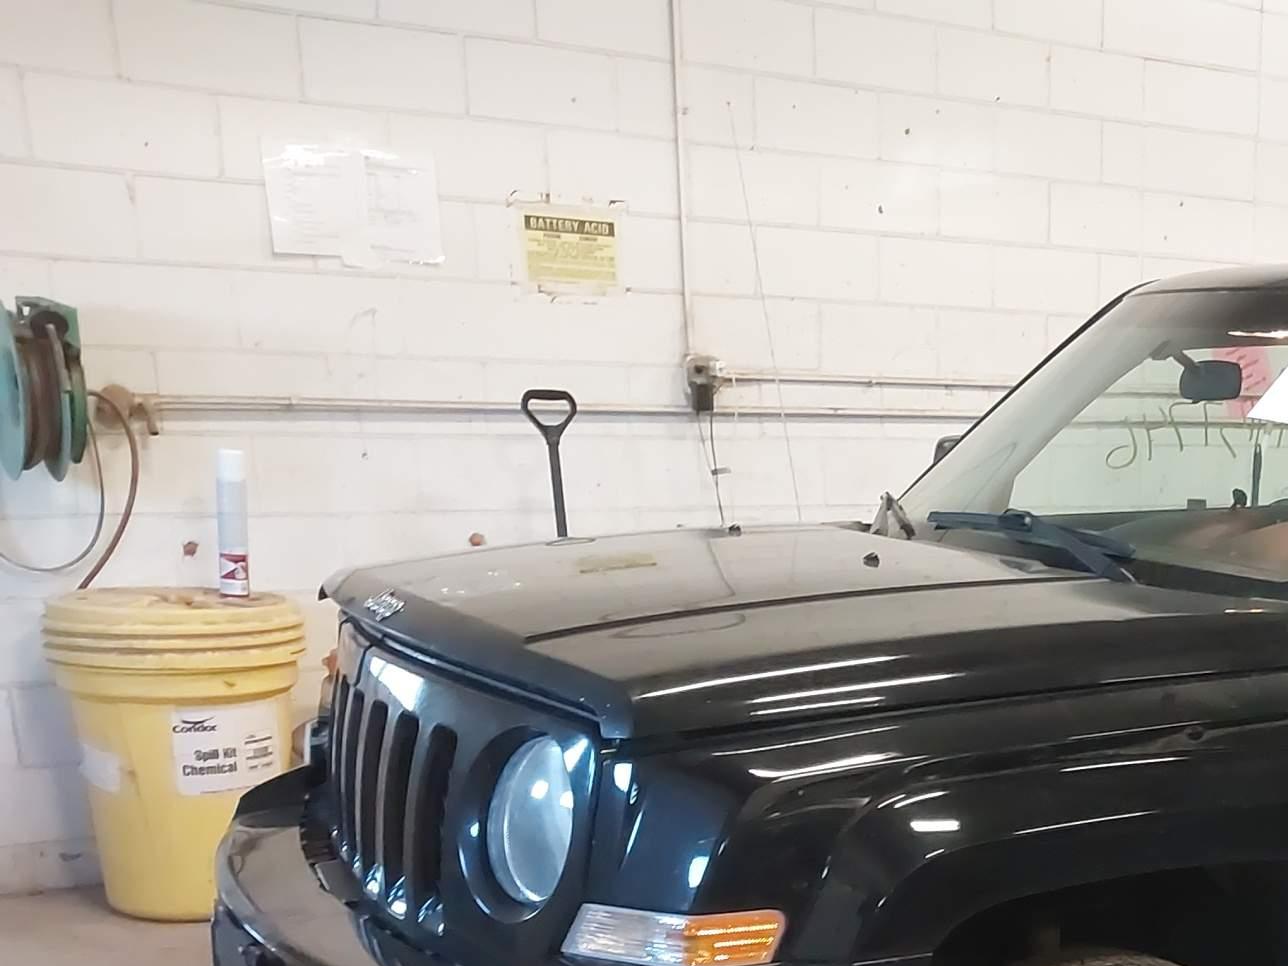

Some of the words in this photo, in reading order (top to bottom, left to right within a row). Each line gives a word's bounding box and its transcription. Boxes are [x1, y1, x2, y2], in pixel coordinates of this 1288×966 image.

[529, 216, 579, 232] BATTERY
[584, 222, 610, 235] ACID
[182, 761, 237, 776] Chemical
